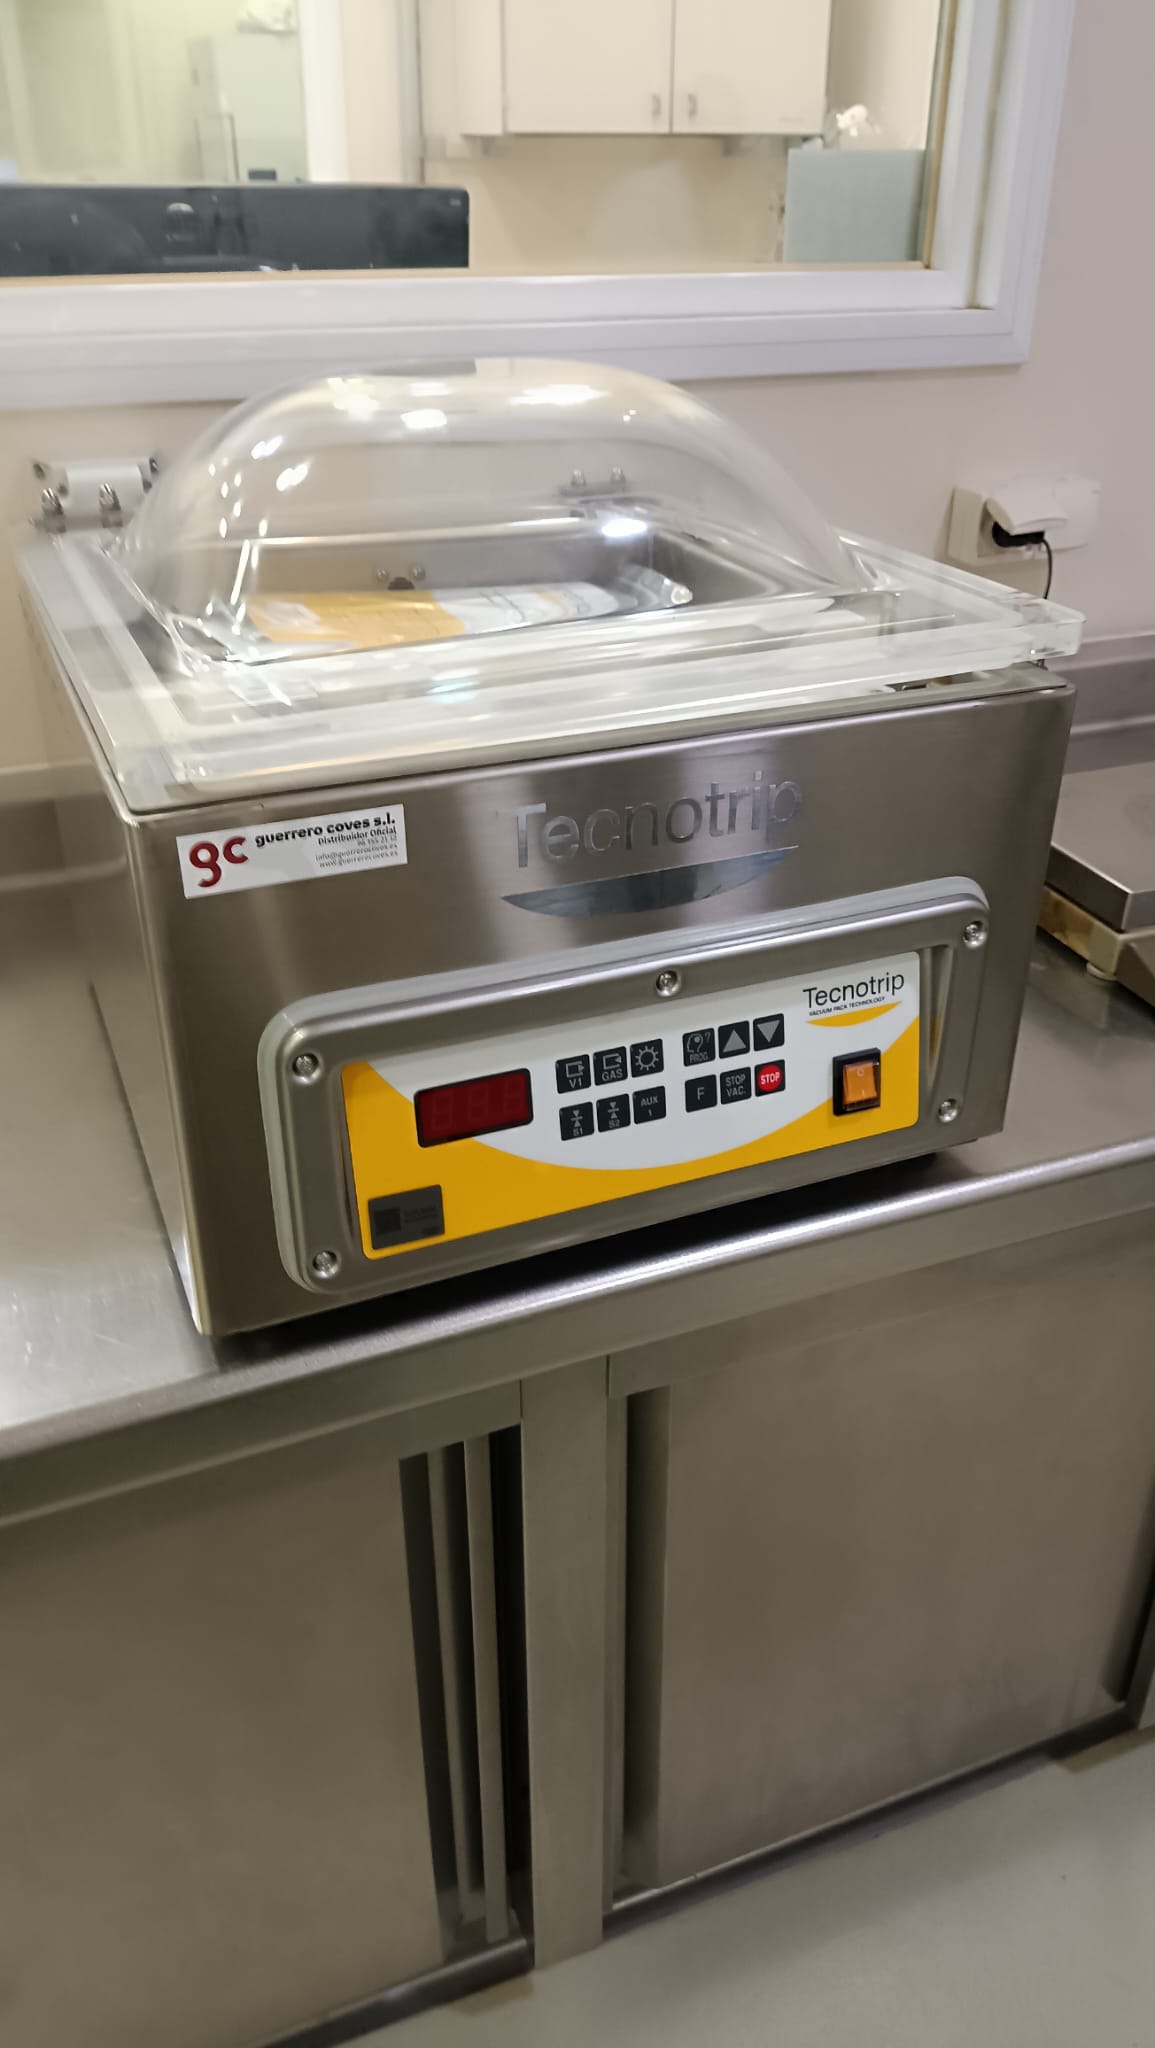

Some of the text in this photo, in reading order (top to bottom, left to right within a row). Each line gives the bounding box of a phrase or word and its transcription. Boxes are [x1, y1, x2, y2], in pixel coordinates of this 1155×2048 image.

[512, 770, 803, 867] Tecnotrip
[255, 812, 396, 847] guerrero coves s.l.
[318, 825, 397, 845] Distribuidor Oficial
[189, 836, 249, 887] gc
[802, 972, 905, 1009] Tecnotrip
[809, 1007, 832, 1017] VACUUM
[849, 996, 886, 1008] TECHNOLOGY
[569, 1077, 583, 1089] V1
[602, 1069, 623, 1082] GAS
[726, 1074, 746, 1088] STOP
[760, 1071, 781, 1086] STOP
[640, 1095, 659, 1107] AUX
[697, 1087, 705, 1100] F
